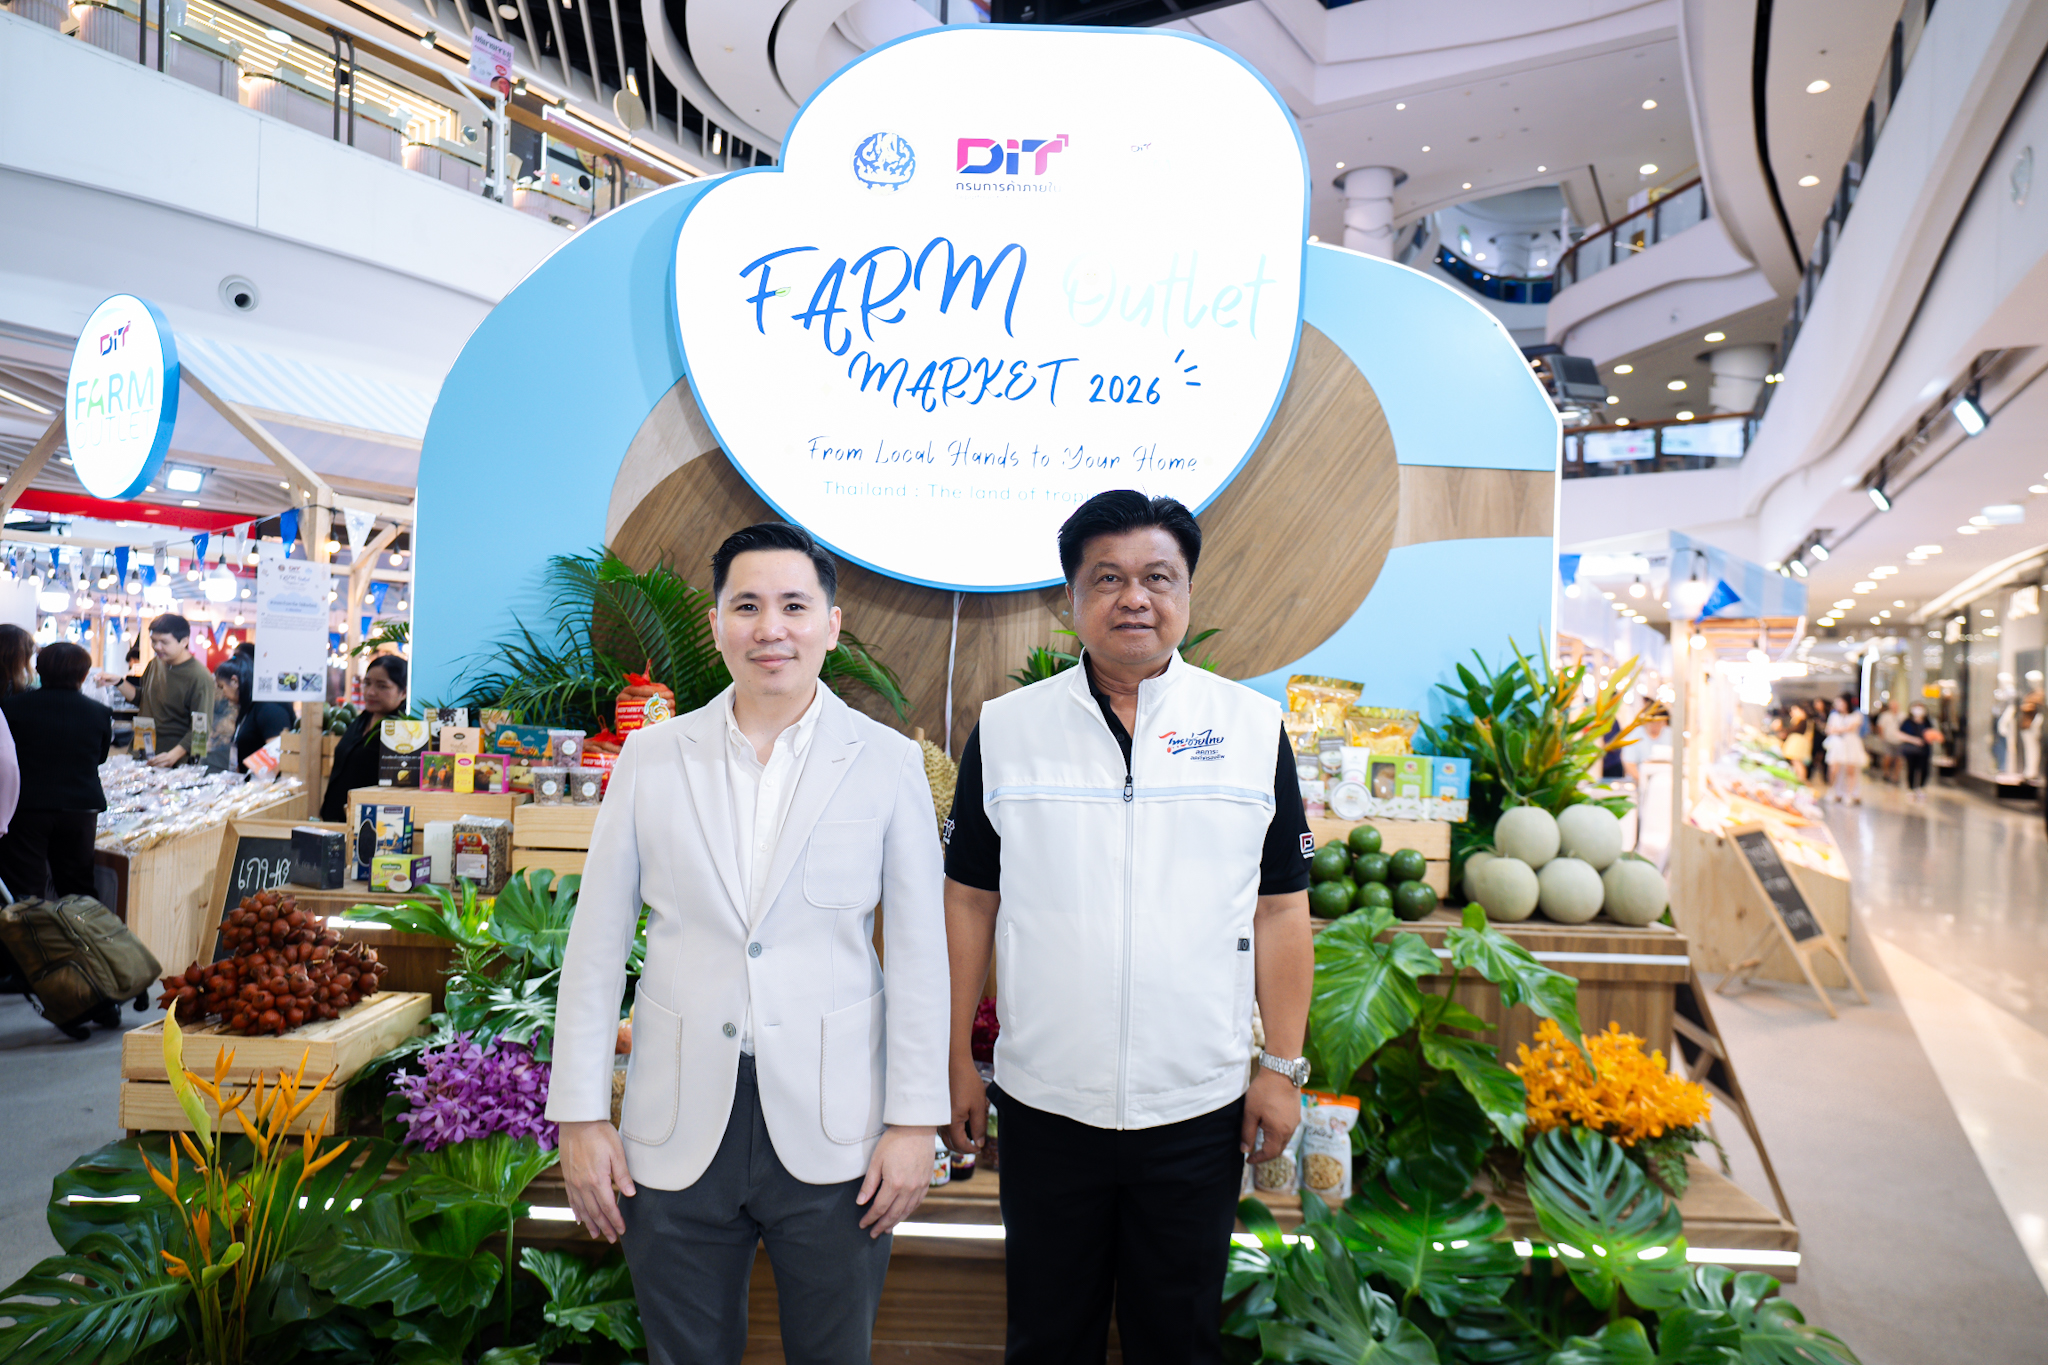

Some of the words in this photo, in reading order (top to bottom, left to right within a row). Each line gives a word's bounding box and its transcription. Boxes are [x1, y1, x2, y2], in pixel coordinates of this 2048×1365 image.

[739, 236, 1027, 356] FARM
[1062, 249, 1278, 341] Outlet
[75, 366, 154, 421] FARM
[848, 350, 1080, 413] MARKET
[1089, 374, 1161, 405] 2026
[74, 408, 154, 450] OUTLET
[808, 435, 863, 462] From
[875, 439, 935, 465] Local
[947, 437, 1020, 469] Hands
[1032, 444, 1050, 469] to
[1062, 444, 1121, 471] Your
[1133, 443, 1198, 473] Home
[823, 481, 906, 497] Thailand
[928, 484, 962, 499] The
[970, 487, 1010, 501] land
[1018, 487, 1036, 501] of
